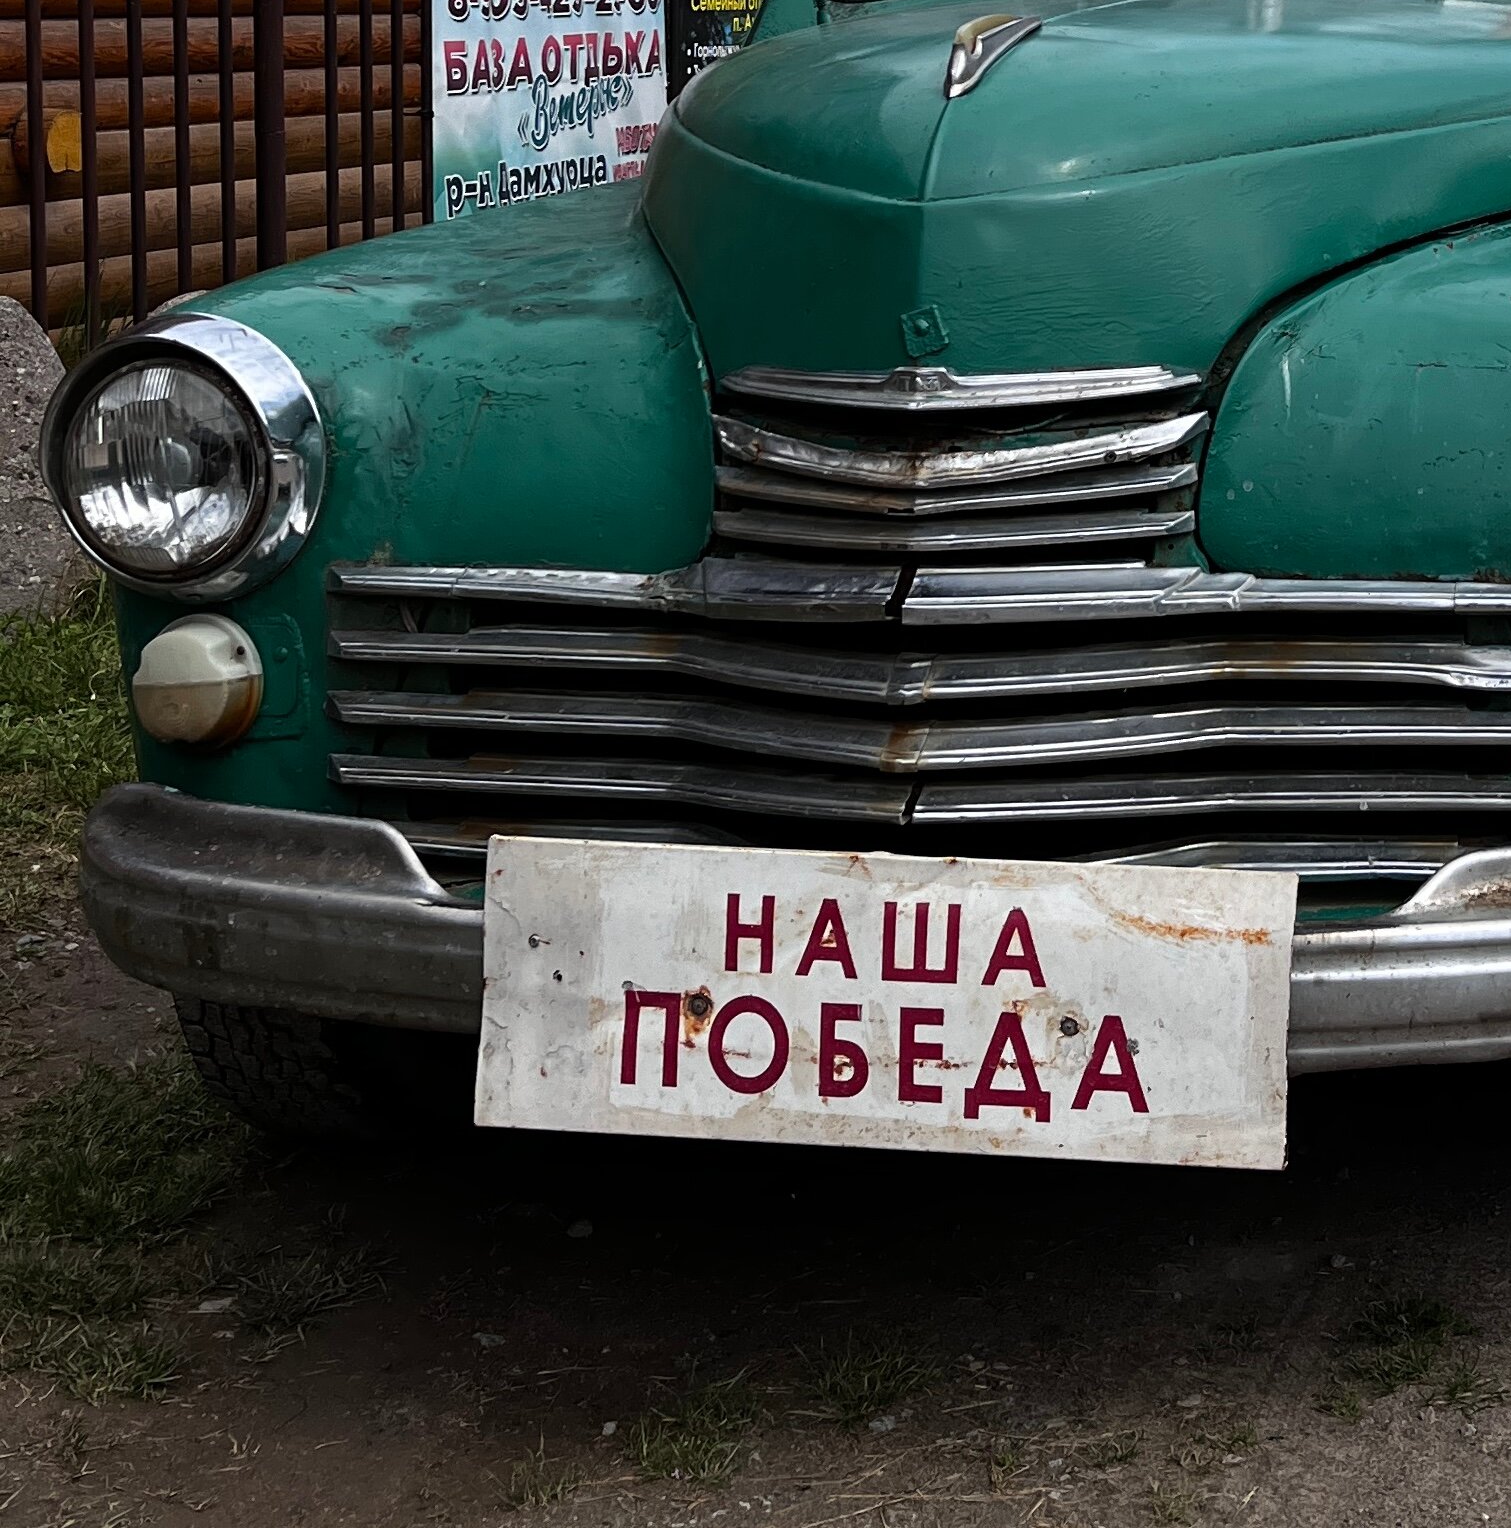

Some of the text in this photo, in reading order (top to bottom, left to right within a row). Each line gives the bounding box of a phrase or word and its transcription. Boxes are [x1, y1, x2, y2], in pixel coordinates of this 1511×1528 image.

[443, 36, 534, 93] БАЗА
[445, 173, 496, 218] р-н
[724, 892, 1047, 988] НАША
[619, 989, 1150, 1123] ПОБЕДА
